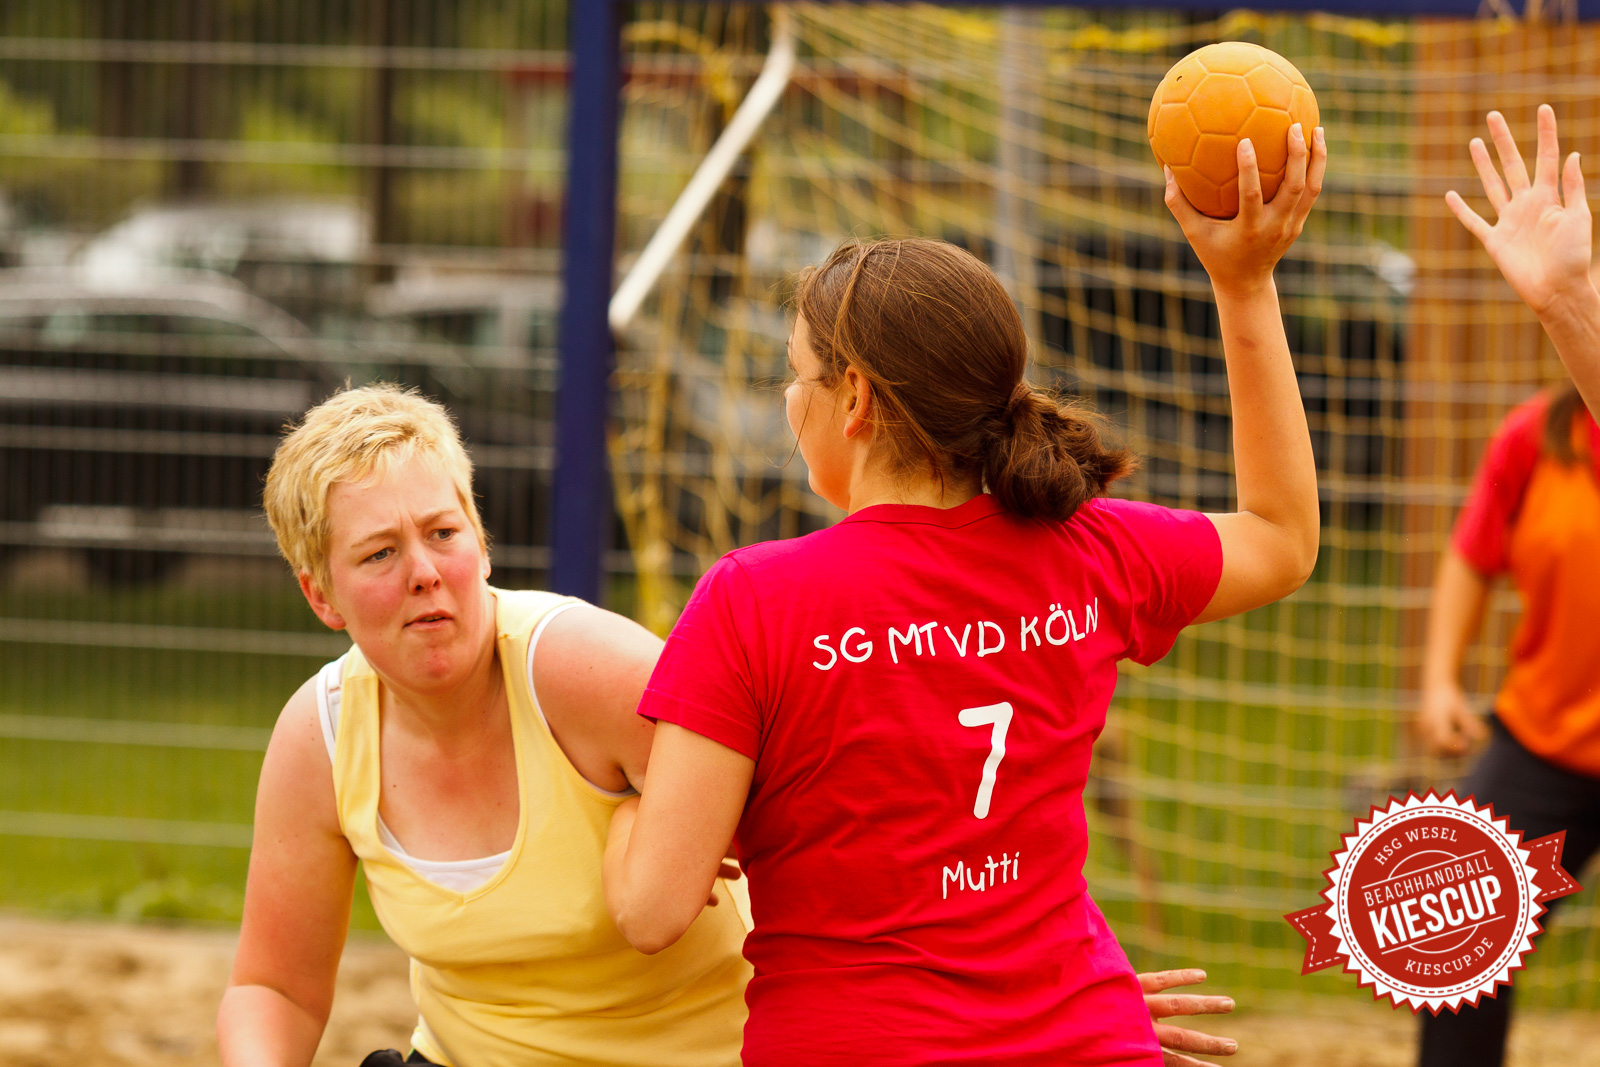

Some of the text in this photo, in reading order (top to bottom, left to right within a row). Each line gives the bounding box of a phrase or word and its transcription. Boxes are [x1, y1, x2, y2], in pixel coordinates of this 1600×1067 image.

[812, 626, 873, 671] SG
[1020, 597, 1099, 652] KÖLN
[958, 701, 1014, 820] 7
[942, 851, 1020, 900] Mutti
